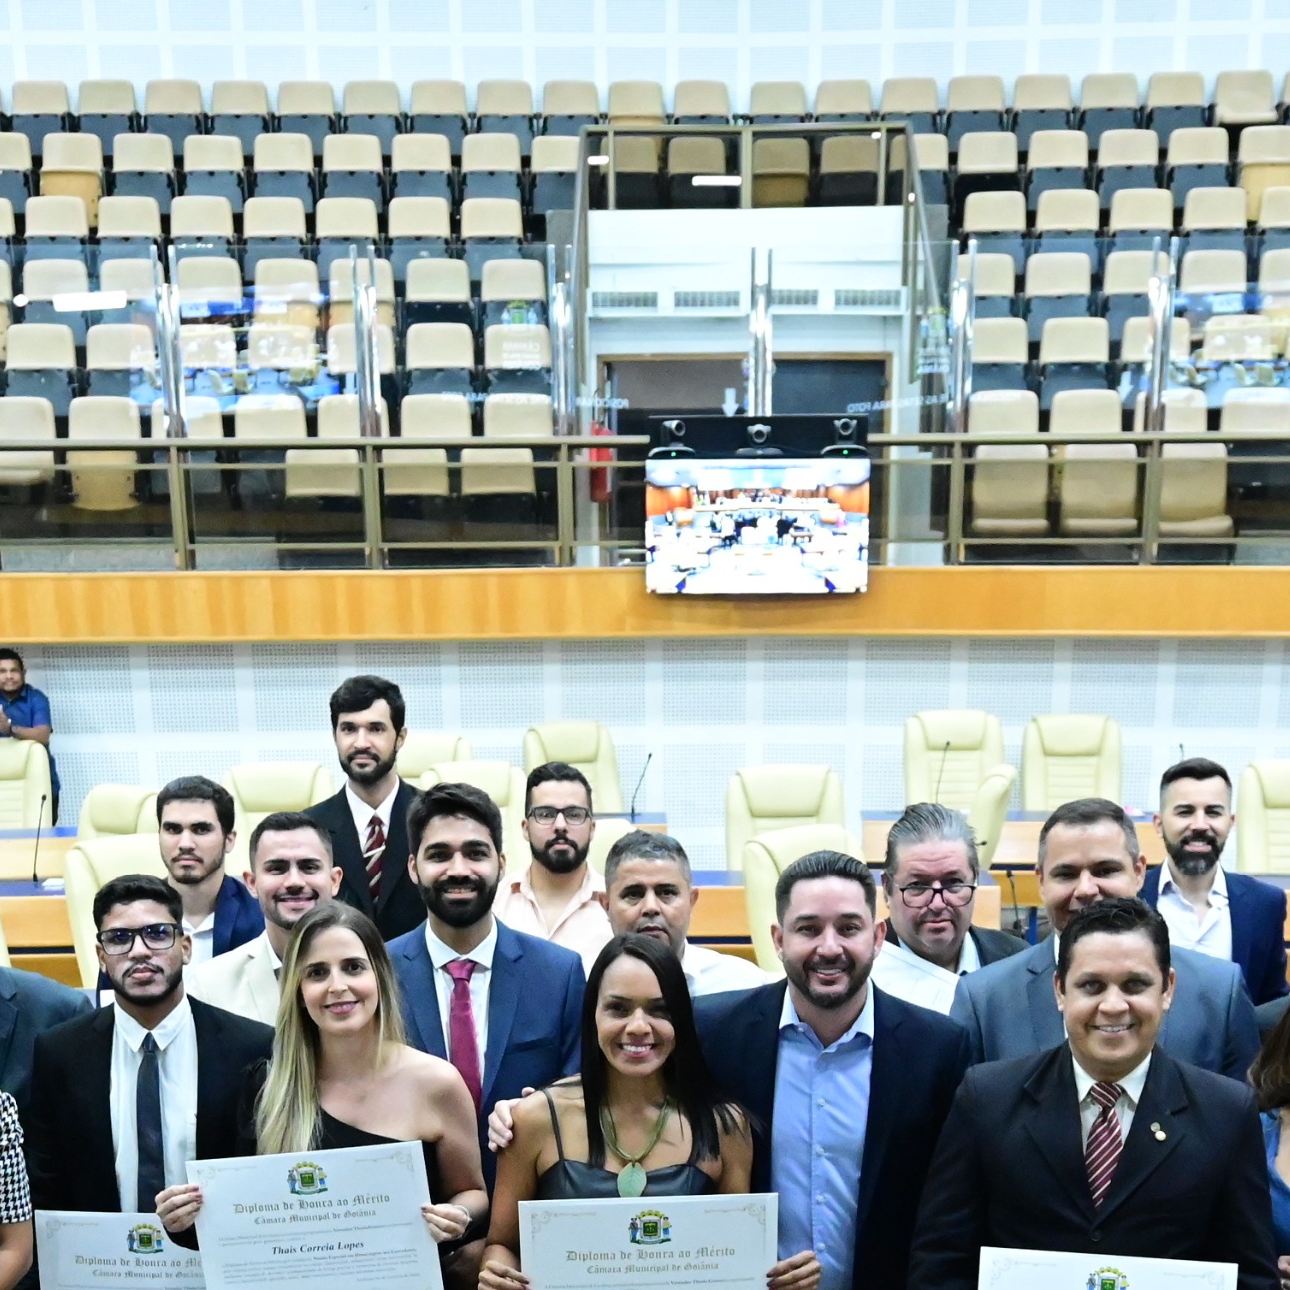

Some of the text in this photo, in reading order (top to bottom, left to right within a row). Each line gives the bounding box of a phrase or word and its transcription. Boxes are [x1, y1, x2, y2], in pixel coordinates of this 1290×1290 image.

[233, 1203, 279, 1214] Diploma
[283, 1202, 293, 1210] de
[298, 1199, 333, 1209] Honra
[353, 1195, 389, 1206] Mérito
[299, 1243, 335, 1252] Correia
[337, 1242, 365, 1251] Lopes
[566, 1251, 615, 1262] Diploma
[620, 1251, 632, 1260] de
[637, 1249, 674, 1261] Honra
[696, 1246, 735, 1258] Mérito
[75, 1255, 116, 1265] Diploma
[120, 1258, 130, 1266] de
[136, 1258, 166, 1267] Honra
